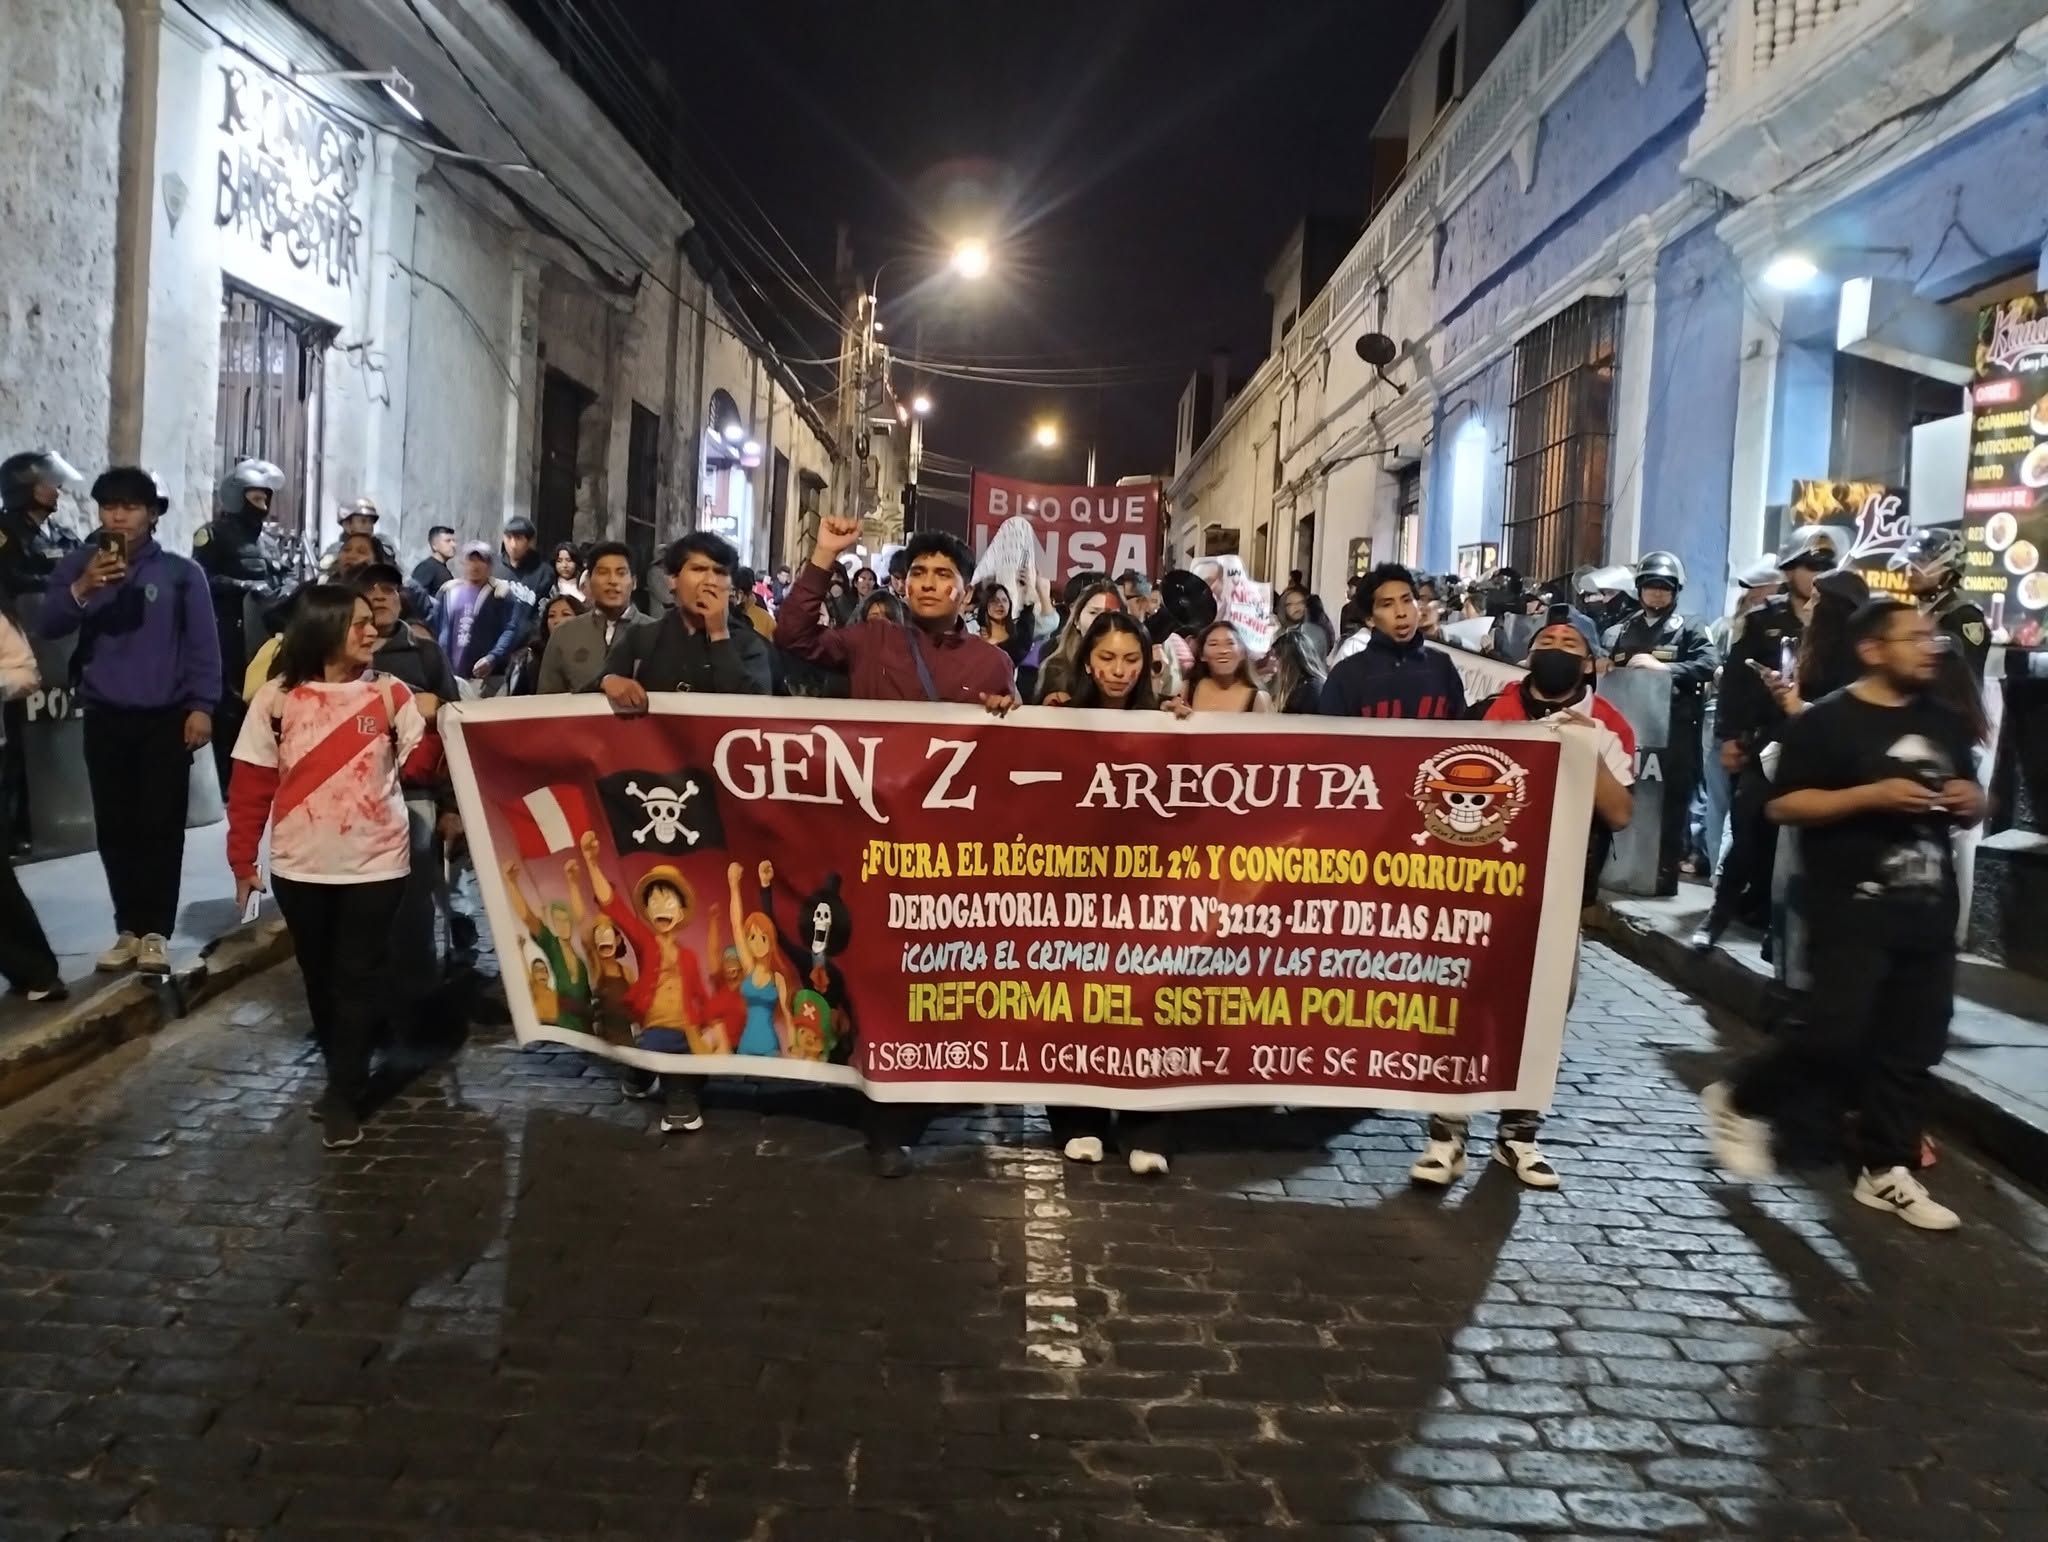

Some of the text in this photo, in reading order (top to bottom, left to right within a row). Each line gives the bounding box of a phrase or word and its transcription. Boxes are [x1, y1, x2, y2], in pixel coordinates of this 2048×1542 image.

[989, 487, 1146, 524] BLOQUE
[356, 715, 377, 735] 12
[712, 725, 889, 823] GEN
[922, 737, 977, 810] Z
[1075, 762, 1384, 818] AREQUIPA
[862, 834, 1526, 896] ¡FUERA EL RÉGIMEN DEL 2% Y CONGRESO CORRUPTO!
[888, 892, 1060, 930] DEROGATORIA
[1064, 892, 1099, 928] DE
[1101, 893, 1134, 930] LA
[1138, 893, 1186, 931] LEY
[1341, 900, 1376, 937] DE
[1379, 903, 1429, 940] LAS
[1432, 907, 1492, 947] AFP!
[901, 940, 1472, 988] ¡CONTRA EL CRIMEN ORGANIZADO Y LAS EXTORCIONES!
[908, 980, 1459, 1036] ¡REFORMA DEL SISTEMA POLICIAL!
[868, 1041, 988, 1071] ¡SOMOS
[999, 1041, 1029, 1071] LA
[1248, 1044, 1314, 1080] QUE
[1323, 1046, 1358, 1076] SE
[1368, 1049, 1490, 1085] RESPETA!
